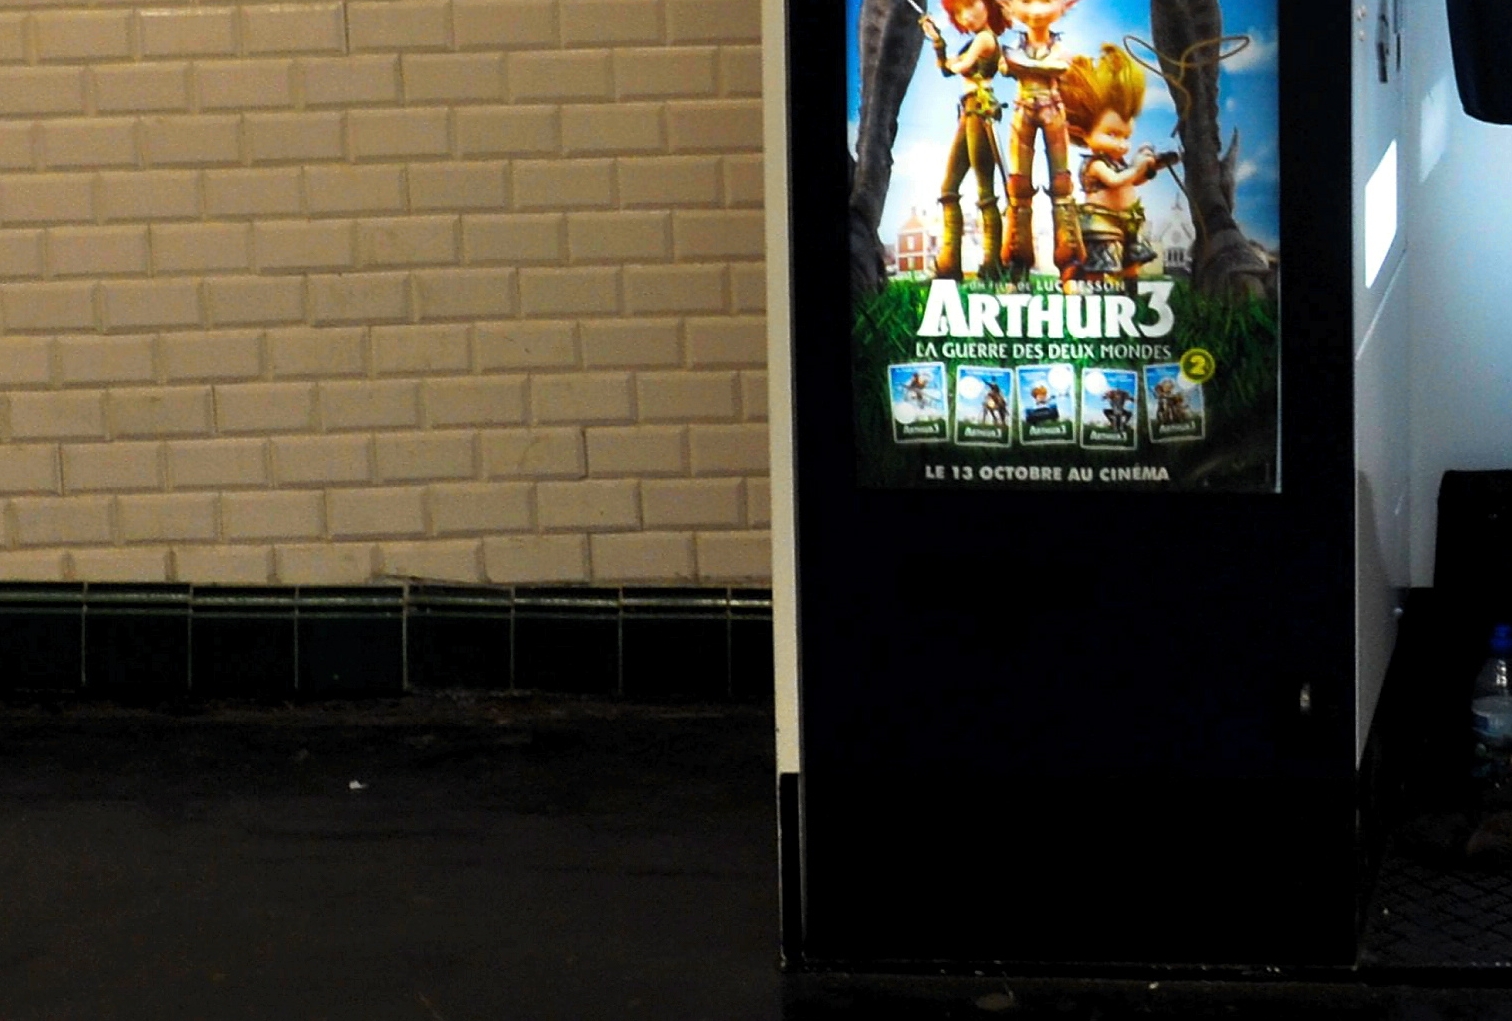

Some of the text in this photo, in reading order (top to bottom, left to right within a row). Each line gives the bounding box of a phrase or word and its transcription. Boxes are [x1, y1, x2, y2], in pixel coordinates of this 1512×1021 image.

[916, 342, 1172, 360] LA GUERRE DES DEUX MONDES
[925, 462, 1170, 482] LE 13 OCTOBRE AU CINÉMA
